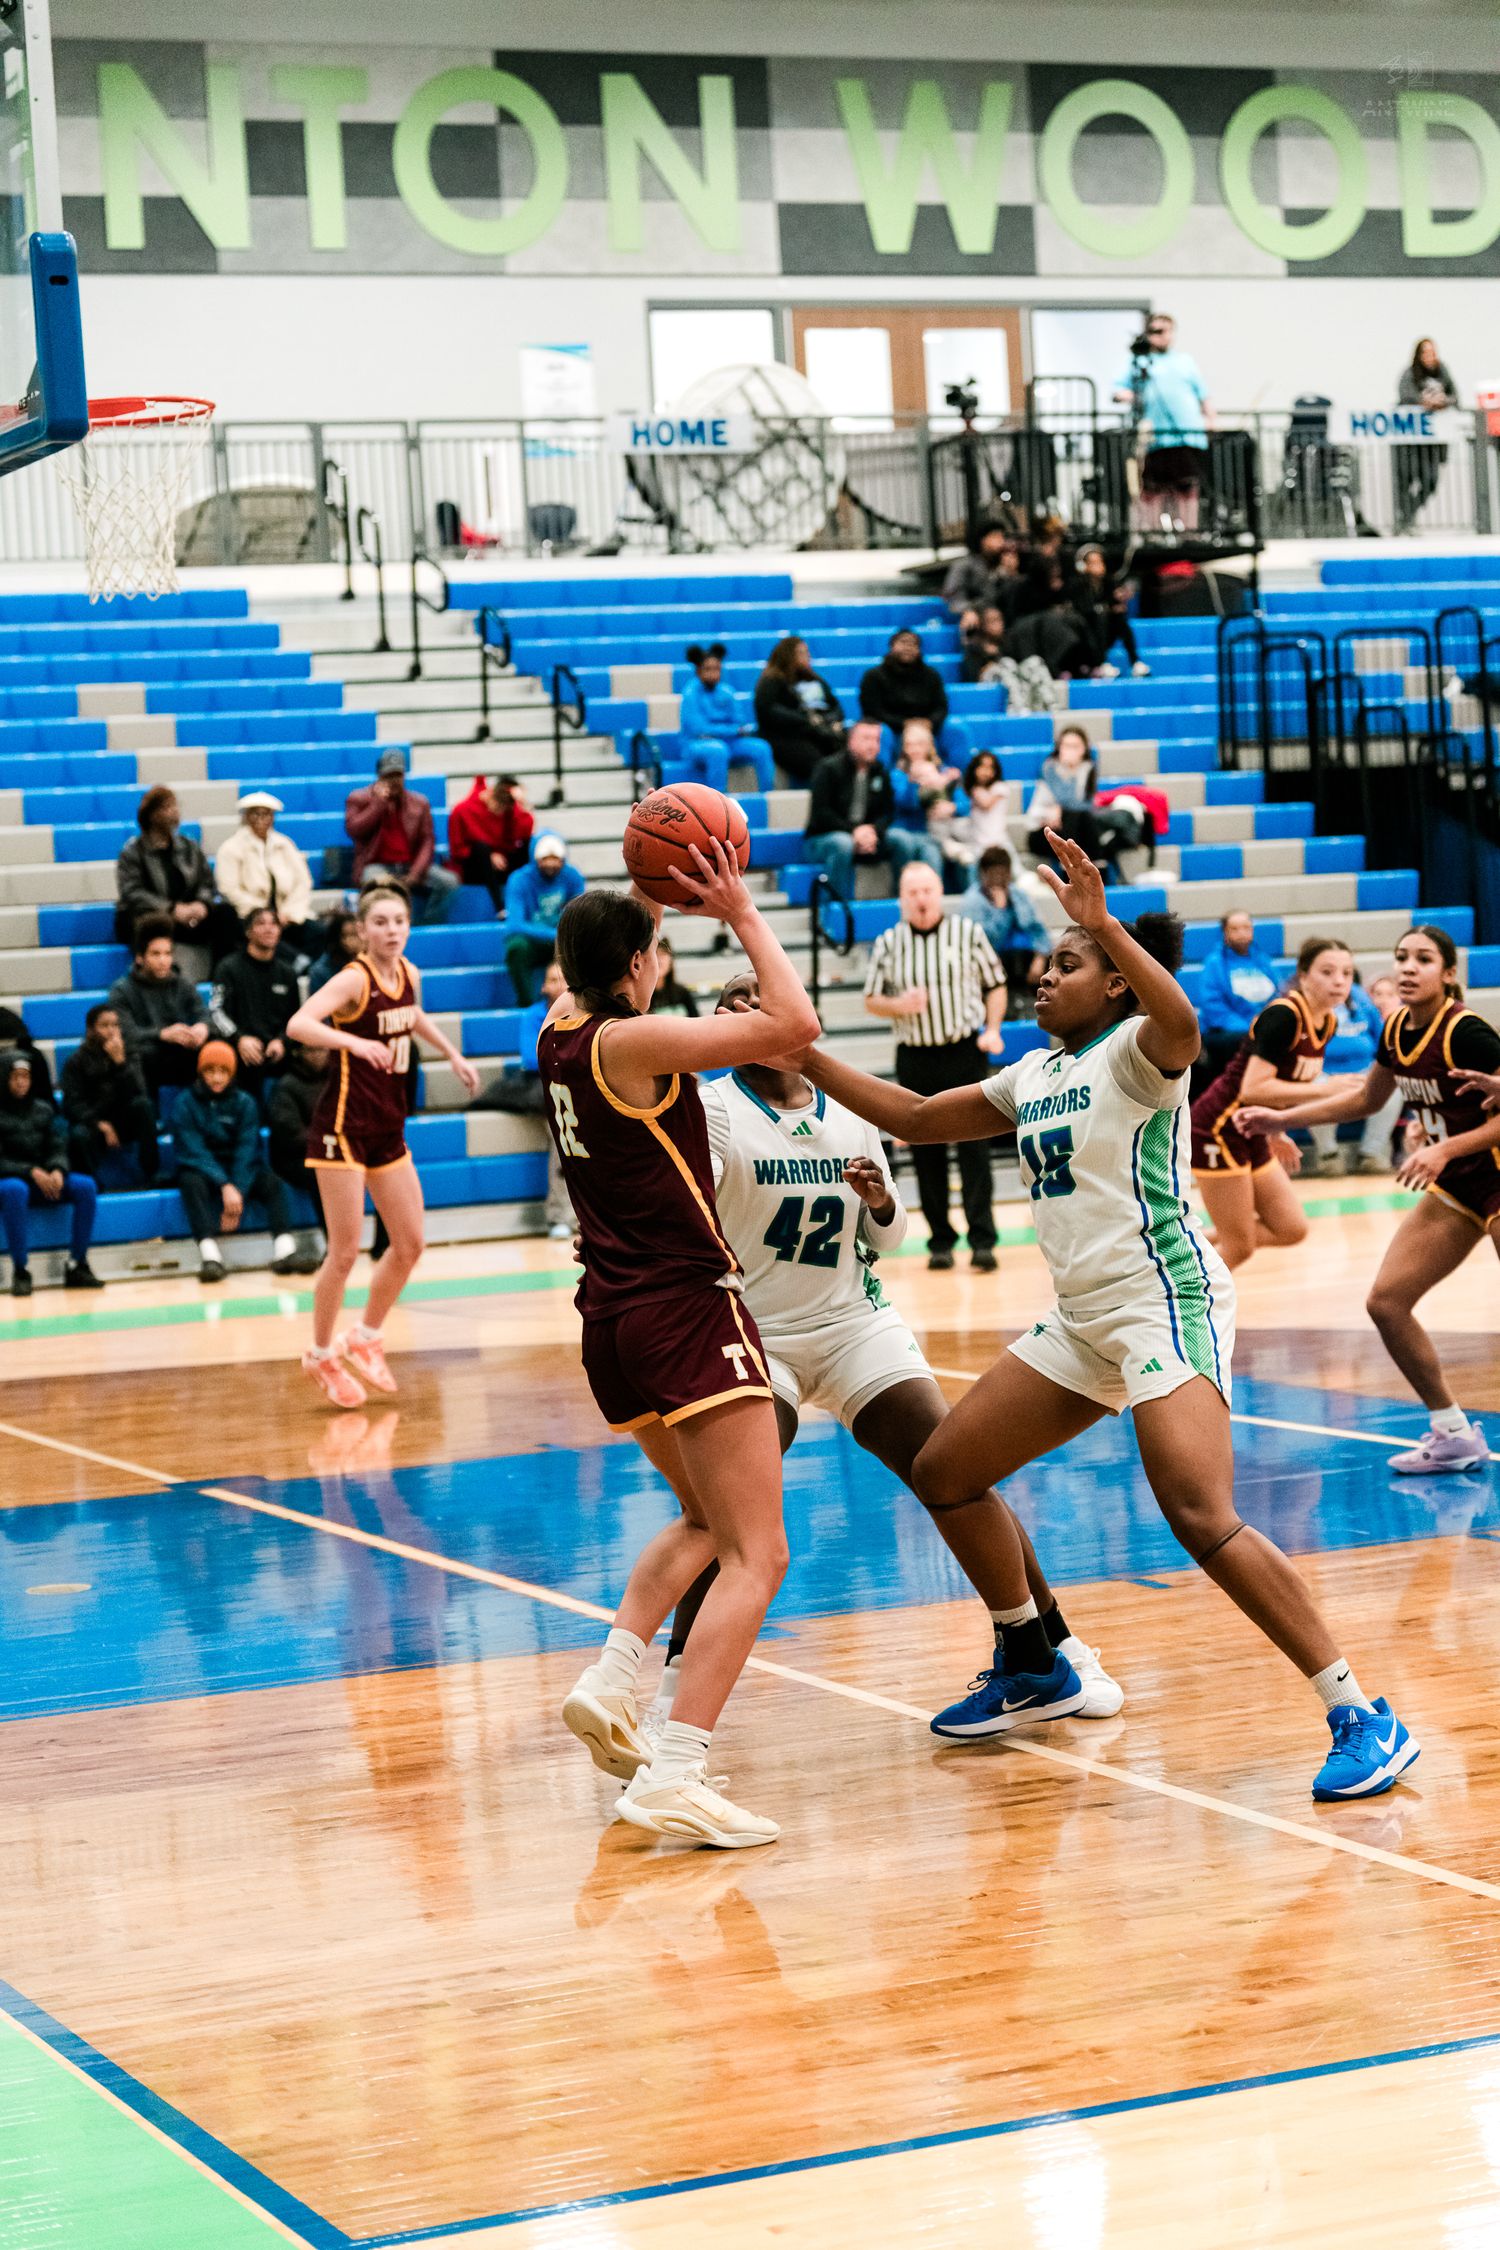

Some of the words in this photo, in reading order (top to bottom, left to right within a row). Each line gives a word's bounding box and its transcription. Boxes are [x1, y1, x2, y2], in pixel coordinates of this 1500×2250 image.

[631, 419, 728, 446] HOME
[1350, 412, 1435, 437] HOME
[1020, 1125, 1077, 1201] 15
[763, 1195, 845, 1269] 42
[721, 1343, 749, 1381] T
